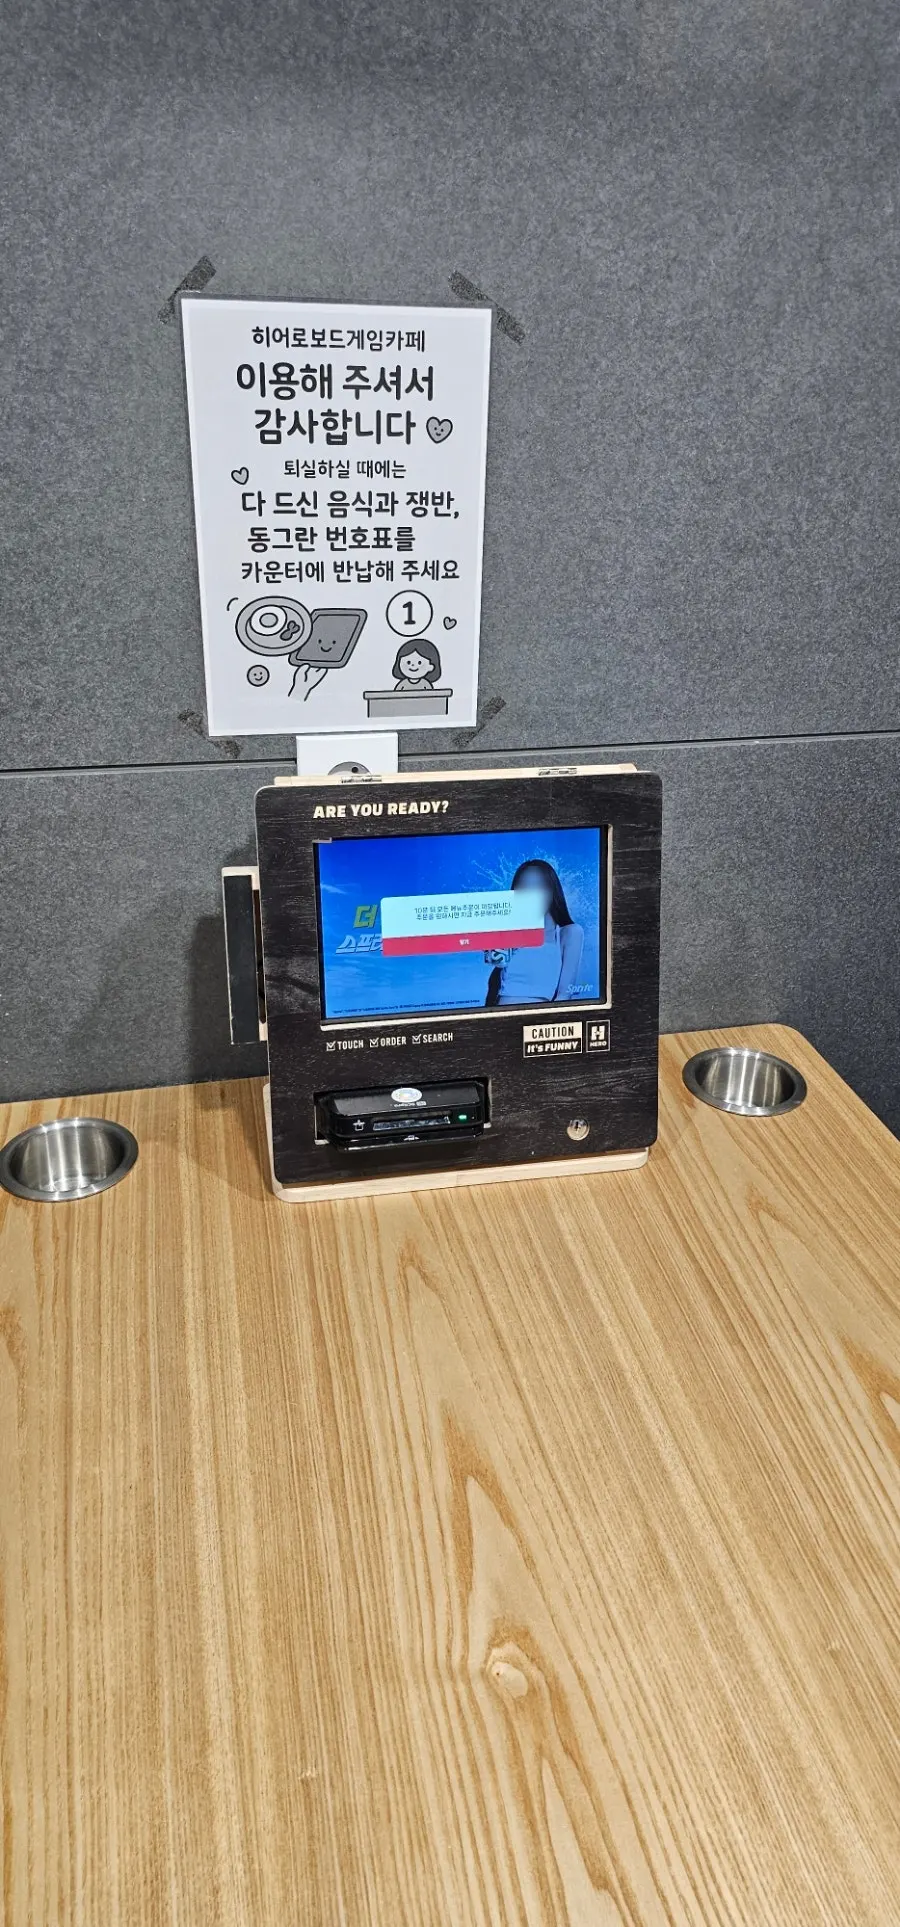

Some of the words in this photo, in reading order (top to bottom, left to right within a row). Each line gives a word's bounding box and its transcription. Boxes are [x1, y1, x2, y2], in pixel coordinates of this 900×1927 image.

[252, 326, 425, 352] 히어로보드게임카페
[236, 362, 333, 400] 이용해
[342, 365, 434, 401] 주셔서
[254, 408, 417, 445] 감사합니다
[283, 459, 350, 479] 퇴실하실
[356, 459, 407, 479] 때에는
[241, 490, 266, 517] 다
[272, 490, 319, 518] 드신
[326, 491, 399, 518] 음식과
[405, 491, 460, 519] 쟁반,
[247, 526, 318, 553] 동그란
[326, 526, 416, 552] 번호표를
[241, 560, 325, 584] 카운터에
[333, 560, 394, 583] 반납해
[401, 560, 460, 582] 주세요
[402, 601, 417, 625] 1
[313, 804, 346, 818] ARE
[351, 803, 383, 817] YOU
[387, 801, 449, 816] READY?
[353, 904, 378, 929] 더
[565, 983, 594, 994] Sprite
[337, 1039, 364, 1050] TOUCH
[380, 1036, 407, 1047] ORDER
[422, 1032, 454, 1043] SEARCH
[531, 1025, 575, 1040] CAUTION
[589, 1040, 608, 1048] HERO
[526, 1042, 544, 1054] It's
[544, 1040, 579, 1053] FUNNY
